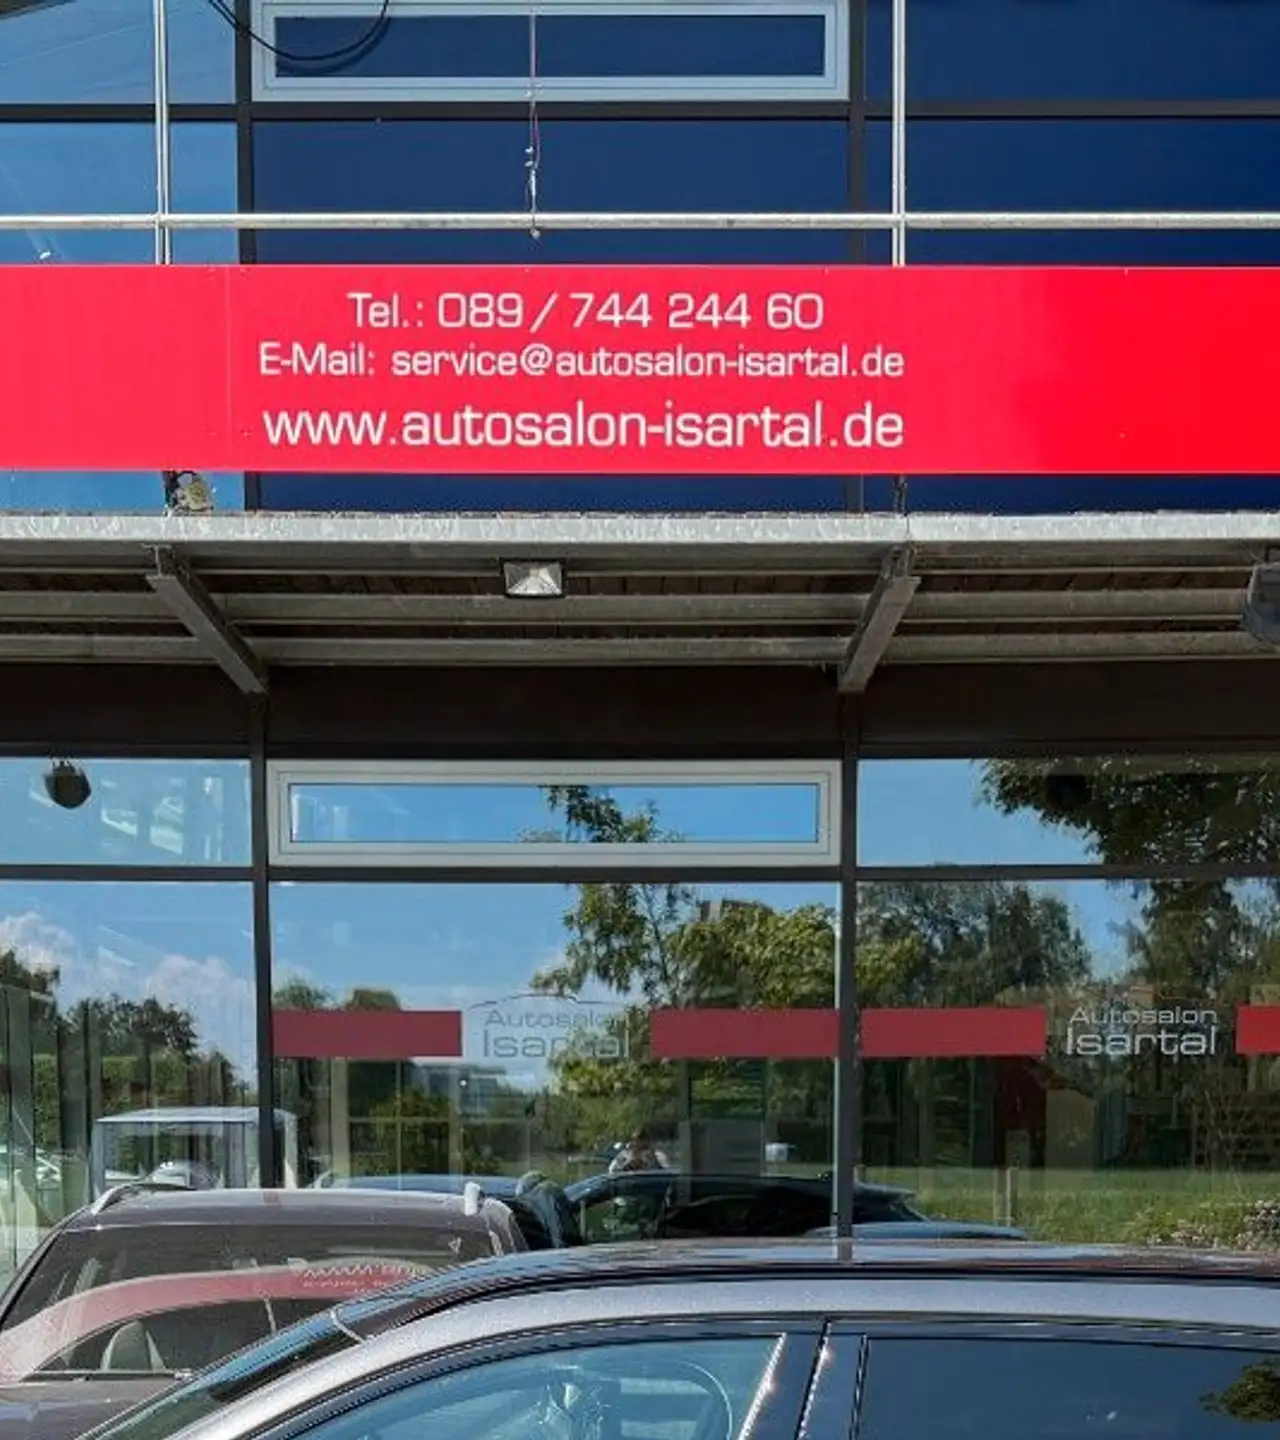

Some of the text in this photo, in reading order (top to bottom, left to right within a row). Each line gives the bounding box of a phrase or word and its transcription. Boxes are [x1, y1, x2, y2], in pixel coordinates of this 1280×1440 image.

[347, 292, 824, 332] Tel.: 089 / 744 244 60
[259, 341, 904, 377] E-Mail: service@autosalon-isartal.de
[262, 399, 904, 447] www.autosalon-isartal.de
[1070, 1005, 1218, 1024] Autosalon
[1066, 1025, 1216, 1055] Isartal
